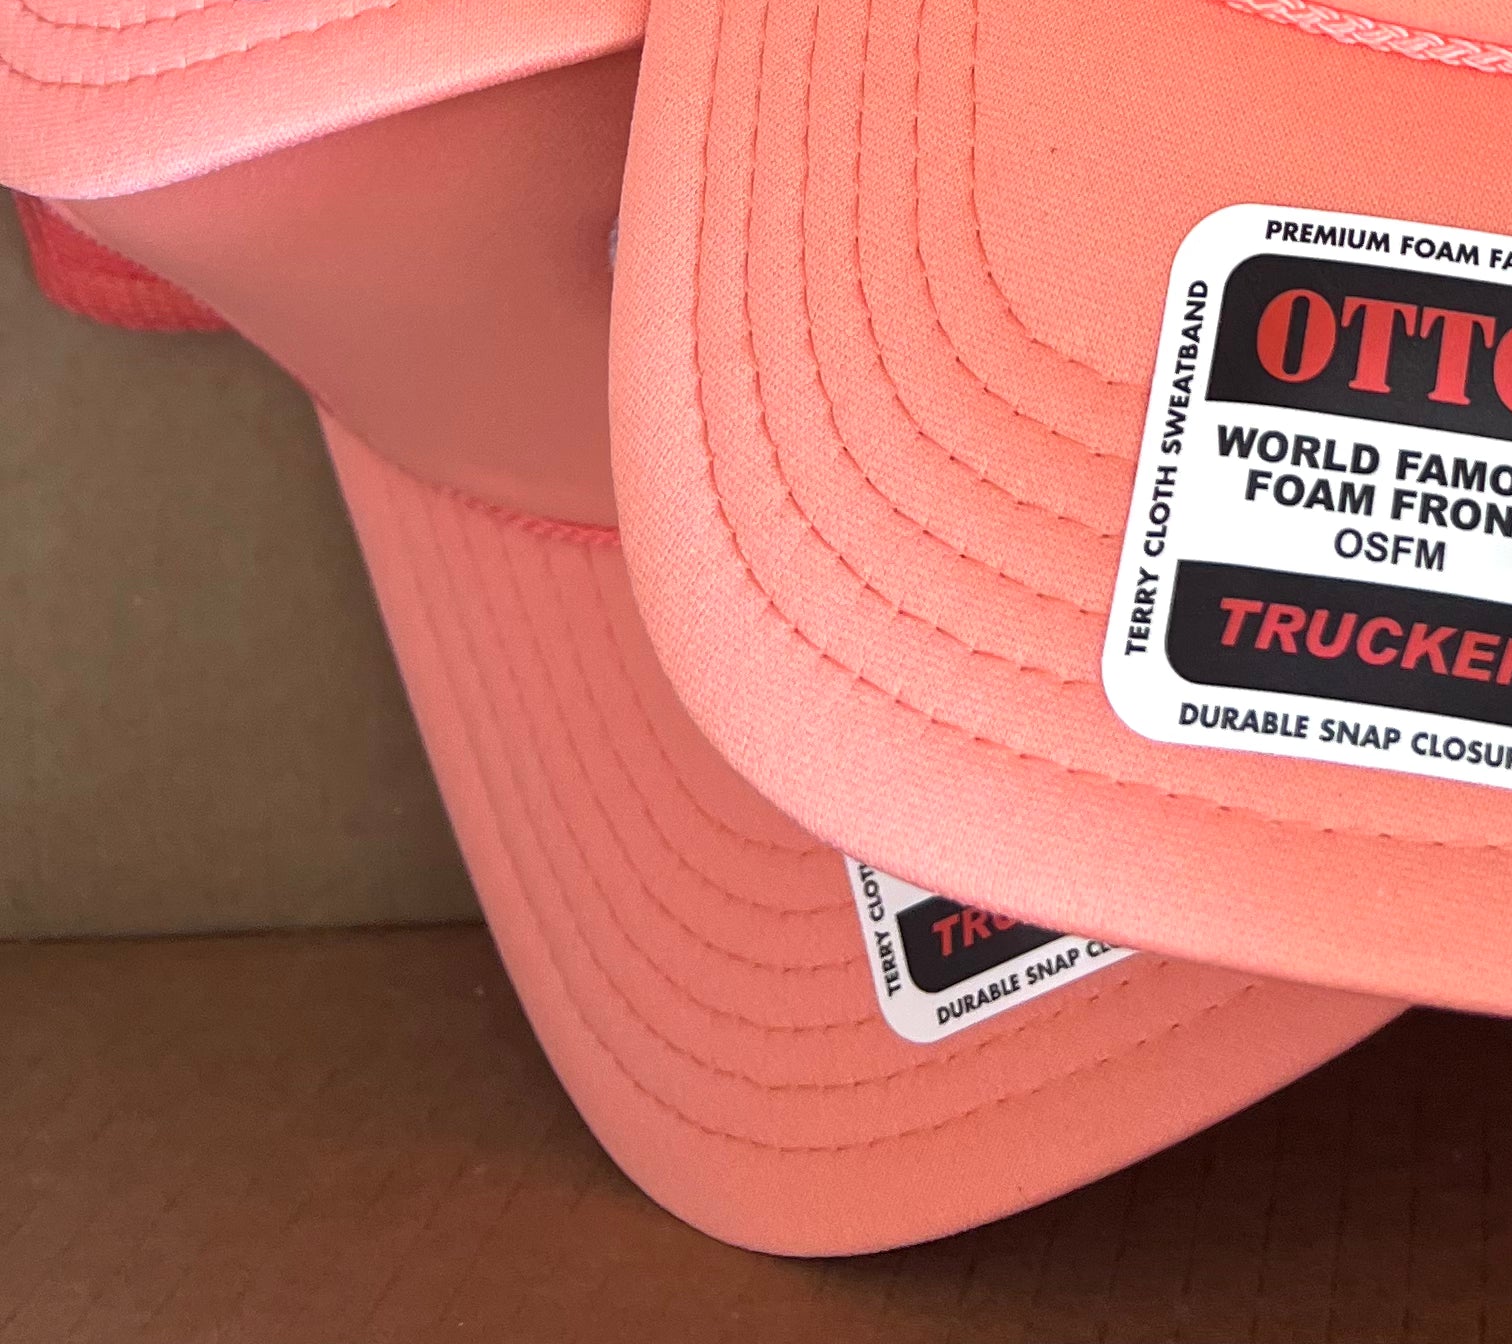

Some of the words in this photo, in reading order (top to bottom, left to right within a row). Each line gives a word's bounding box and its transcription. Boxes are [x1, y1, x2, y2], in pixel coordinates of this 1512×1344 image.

[1265, 219, 1392, 253] PREMIUM
[1400, 236, 1481, 267] FOAM
[1124, 568, 1161, 656] TERRY
[1144, 463, 1178, 556] CLOTH
[1163, 279, 1209, 454] SWEATBAND
[1217, 423, 1381, 475] WORLD
[1245, 470, 1376, 515] FOAM
[1334, 528, 1446, 571] OSFM
[1179, 702, 1308, 738] DURABLE
[1320, 719, 1401, 751] SNAP
[858, 864, 885, 922] CLOT
[874, 930, 901, 997] TERRY
[937, 974, 1020, 1025] DURABLE
[1026, 949, 1080, 985] SNAP
